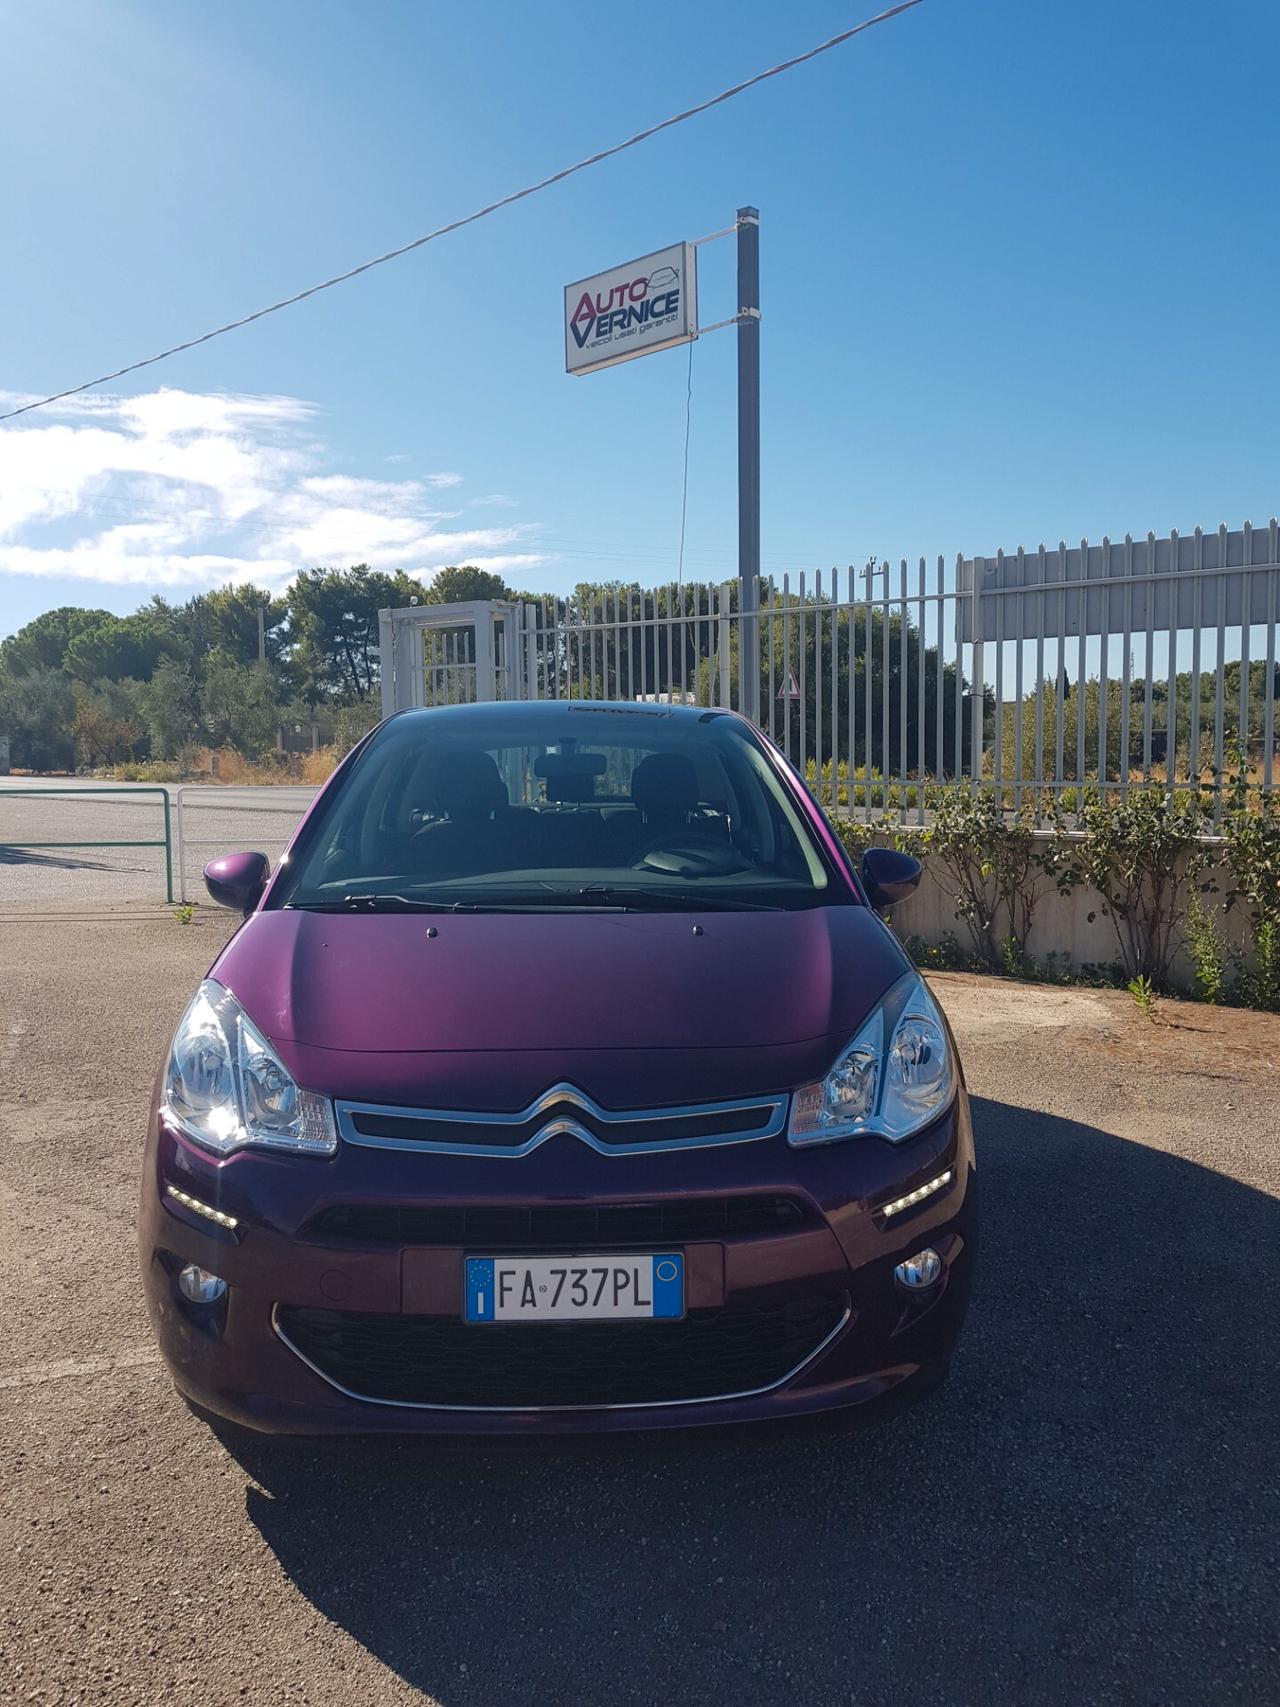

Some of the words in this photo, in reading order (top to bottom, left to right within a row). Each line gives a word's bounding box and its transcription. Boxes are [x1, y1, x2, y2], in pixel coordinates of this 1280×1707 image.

[570, 277, 649, 323] AUTO
[570, 288, 679, 348] VERNICE
[639, 312, 678, 334] garantiti
